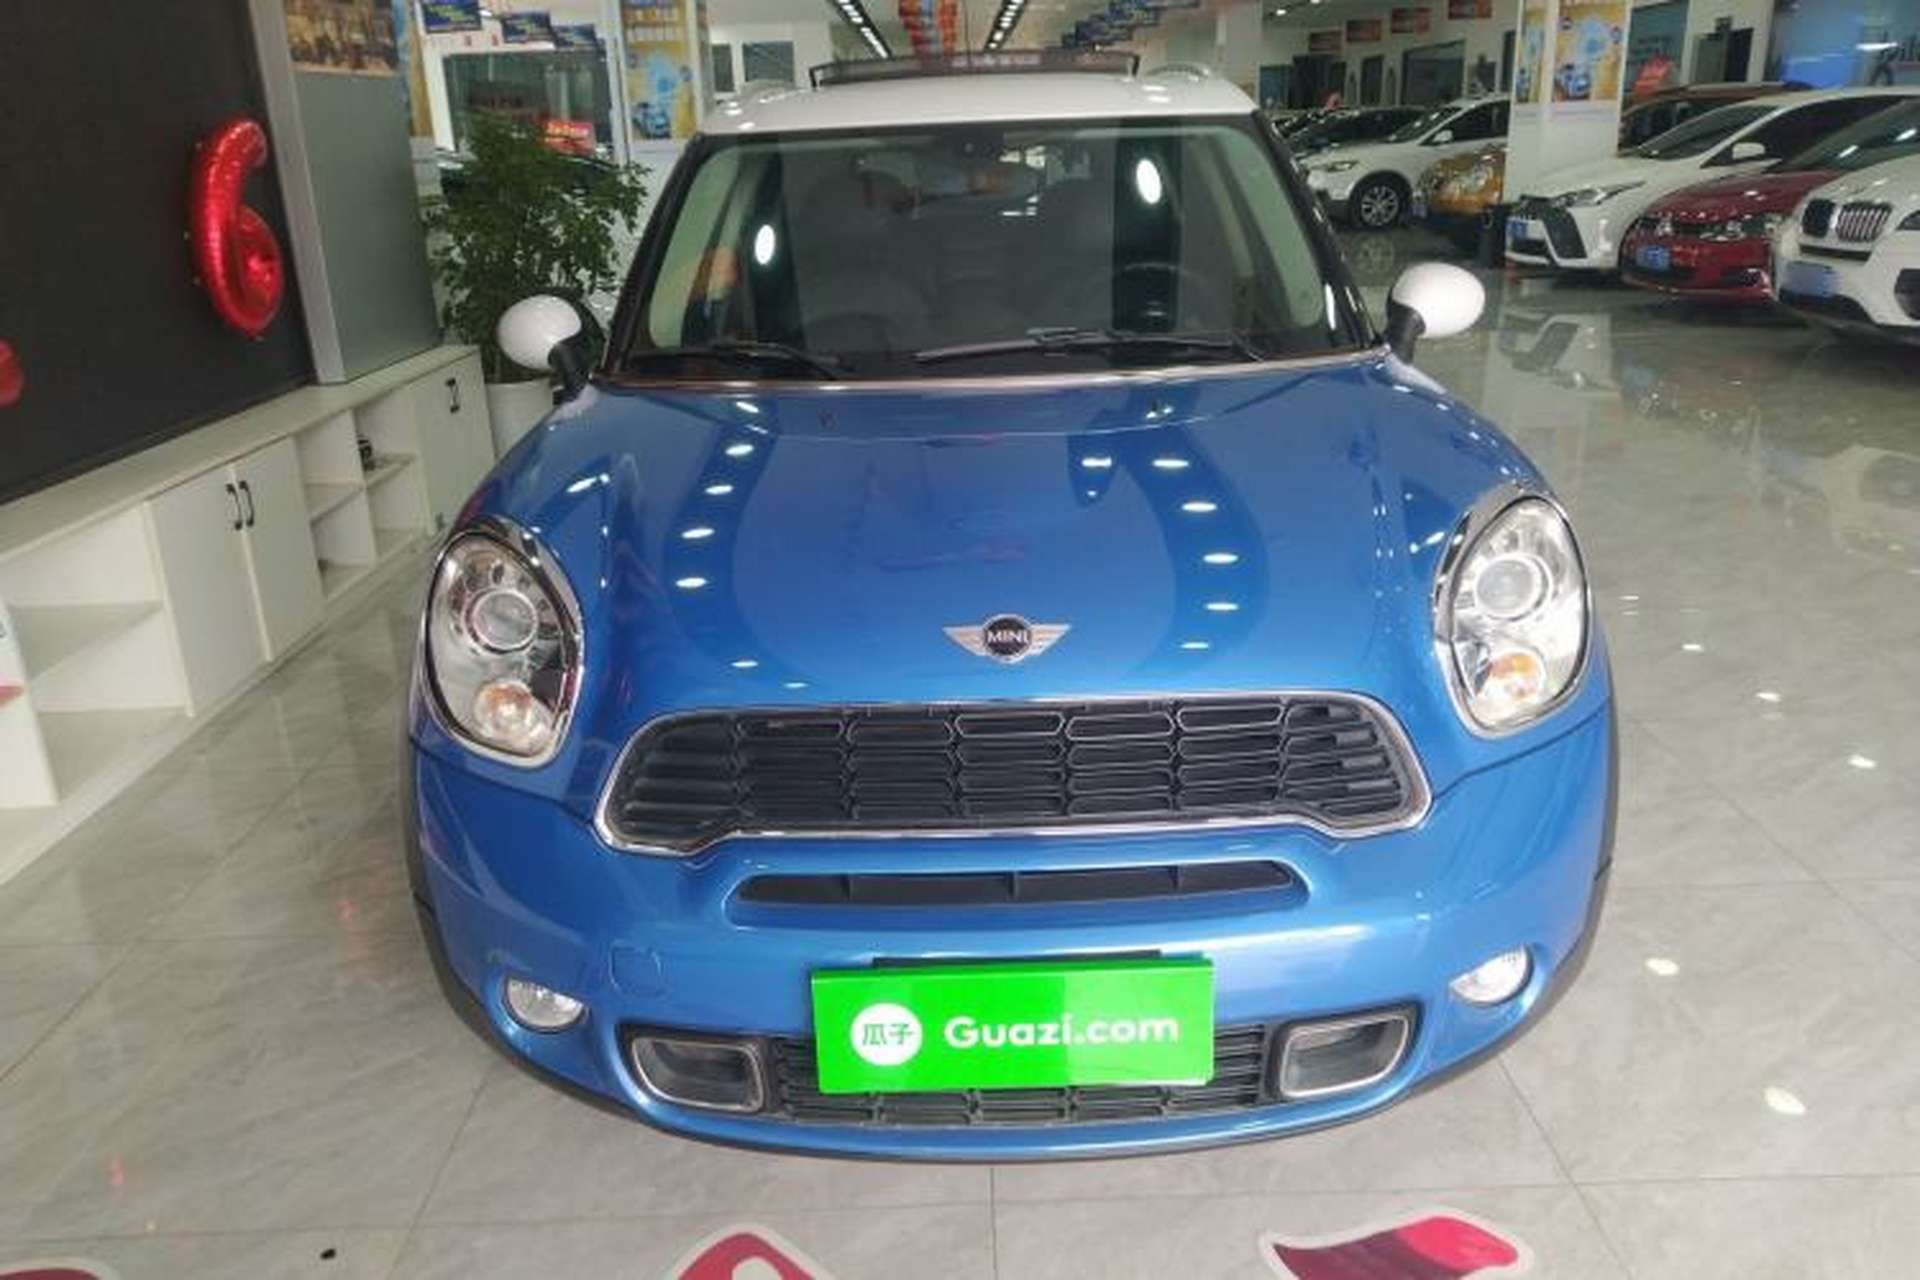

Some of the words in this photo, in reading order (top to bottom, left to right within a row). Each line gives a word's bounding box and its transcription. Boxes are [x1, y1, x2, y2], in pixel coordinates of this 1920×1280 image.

[191, 119, 284, 335] 6
[987, 629, 1029, 644] MINI
[861, 1022, 914, 1046] 瓜子
[943, 1013, 1180, 1049] Guazi.com
